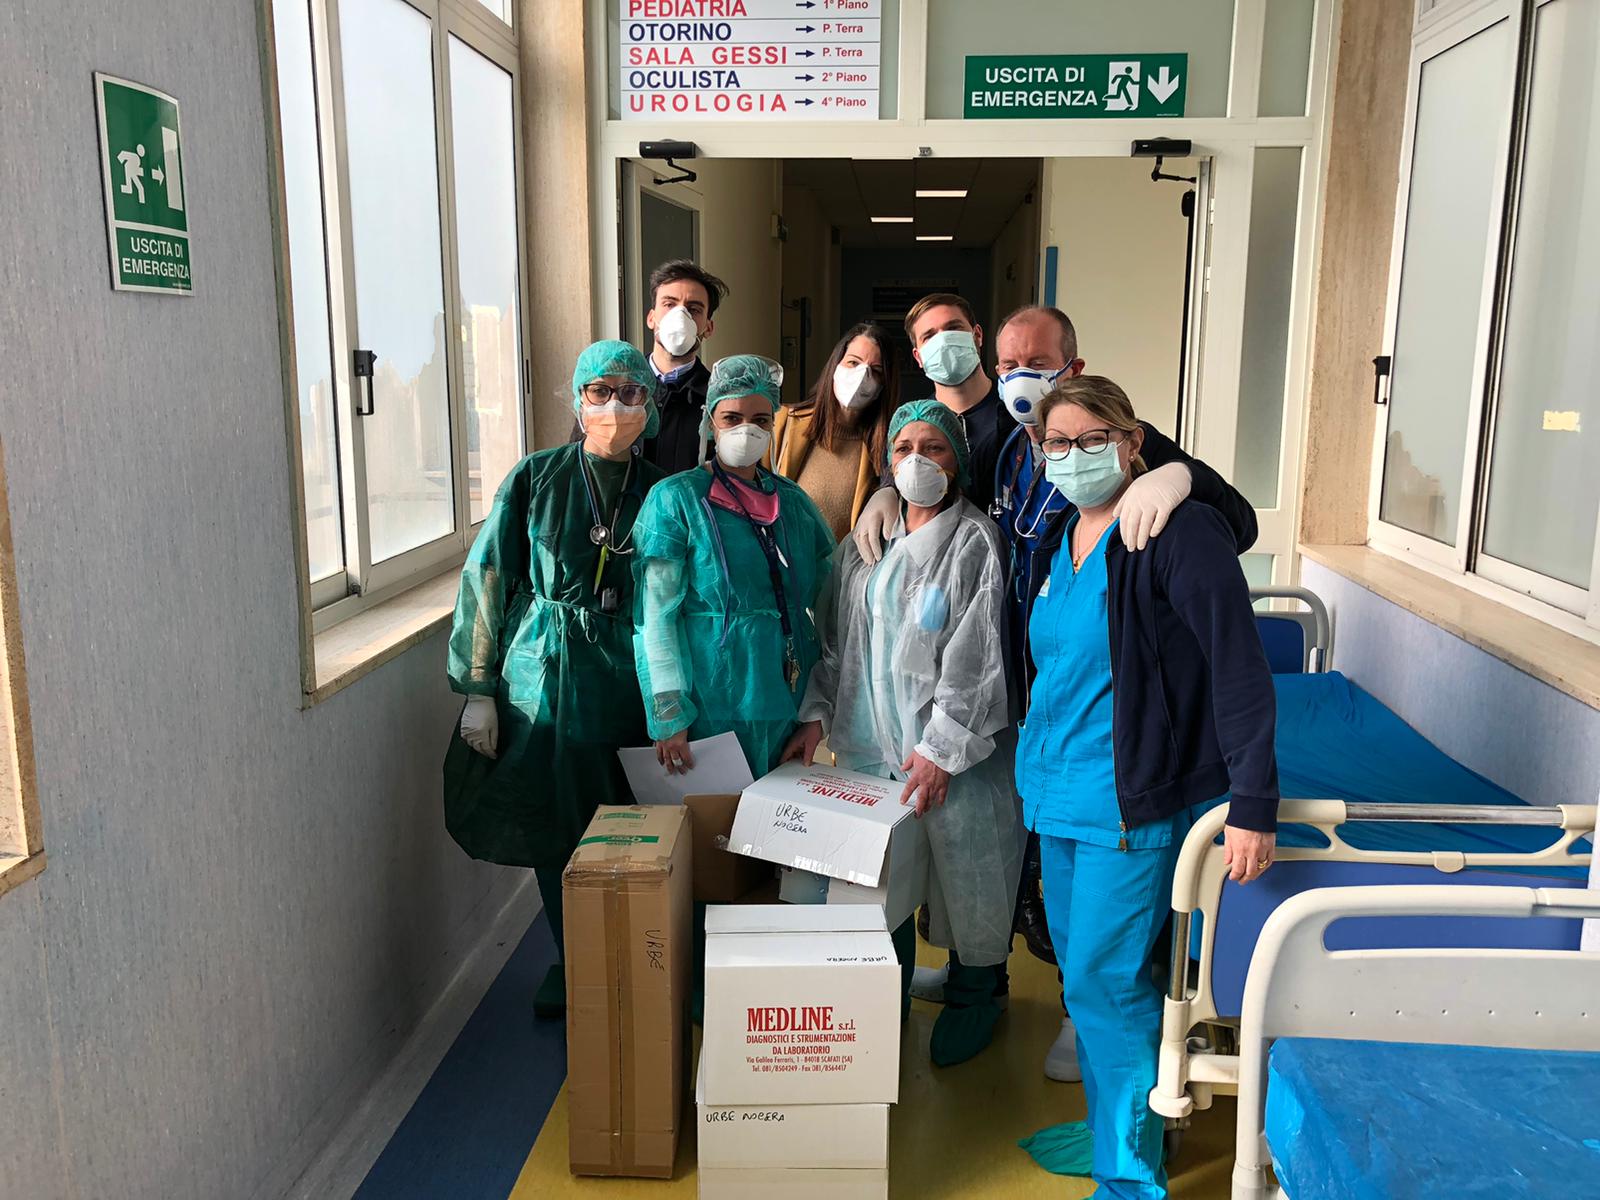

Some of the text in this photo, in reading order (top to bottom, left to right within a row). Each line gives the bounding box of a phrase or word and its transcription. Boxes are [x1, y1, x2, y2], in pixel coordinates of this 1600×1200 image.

[628, 0, 748, 17] PEDIATRIA
[837, 0, 869, 9] Piano
[628, 23, 732, 42] OTORINO
[822, 23, 863, 33] P. Terra
[628, 46, 787, 65] SALA GESSI
[822, 47, 863, 57] P. Terra
[629, 70, 741, 89] OCULISTA
[835, 72, 867, 82] Piano
[985, 66, 1086, 83] USCITA DI
[629, 93, 787, 112] UROLOGIA
[835, 97, 867, 107] Piano
[971, 90, 1099, 107] EMERGENZA
[130, 236, 184, 258] USCITA DI
[122, 257, 190, 279] EMERGENZA
[807, 784, 879, 807] MEDLINE
[775, 802, 808, 823] URBE
[644, 929, 668, 971] URBE
[746, 1006, 856, 1032] MEDLINE s.r.l.
[746, 1033, 856, 1044] DIAGNOSTICI E STRUMENTAZIONE
[772, 1045, 831, 1055] DA LABORATORIO
[820, 1055, 841, 1063] SCAFATI
[841, 1055, 853, 1064] (SA)
[705, 1110, 785, 1123] URBE NOCERA
